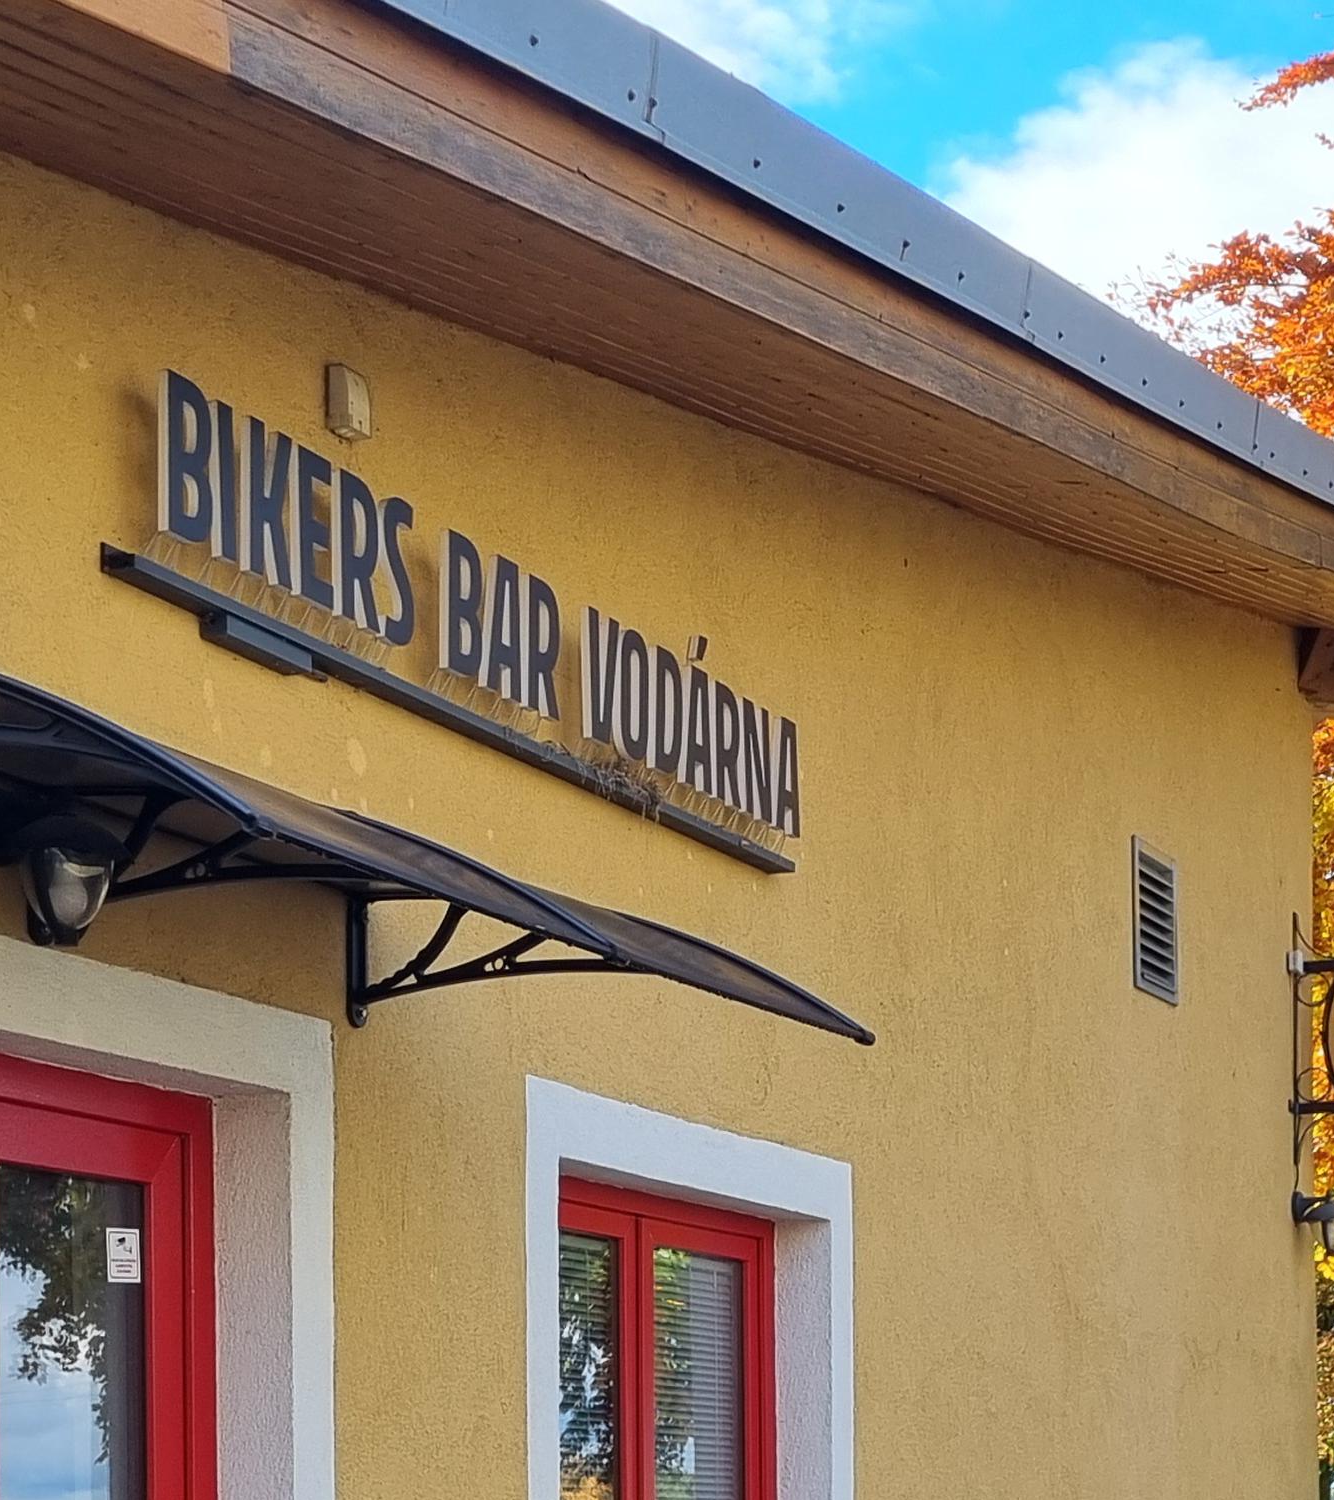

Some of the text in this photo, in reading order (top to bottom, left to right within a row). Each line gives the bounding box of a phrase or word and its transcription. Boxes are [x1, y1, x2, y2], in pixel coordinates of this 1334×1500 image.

[157, 369, 800, 838] BIKERS BAR VODÁRNA
